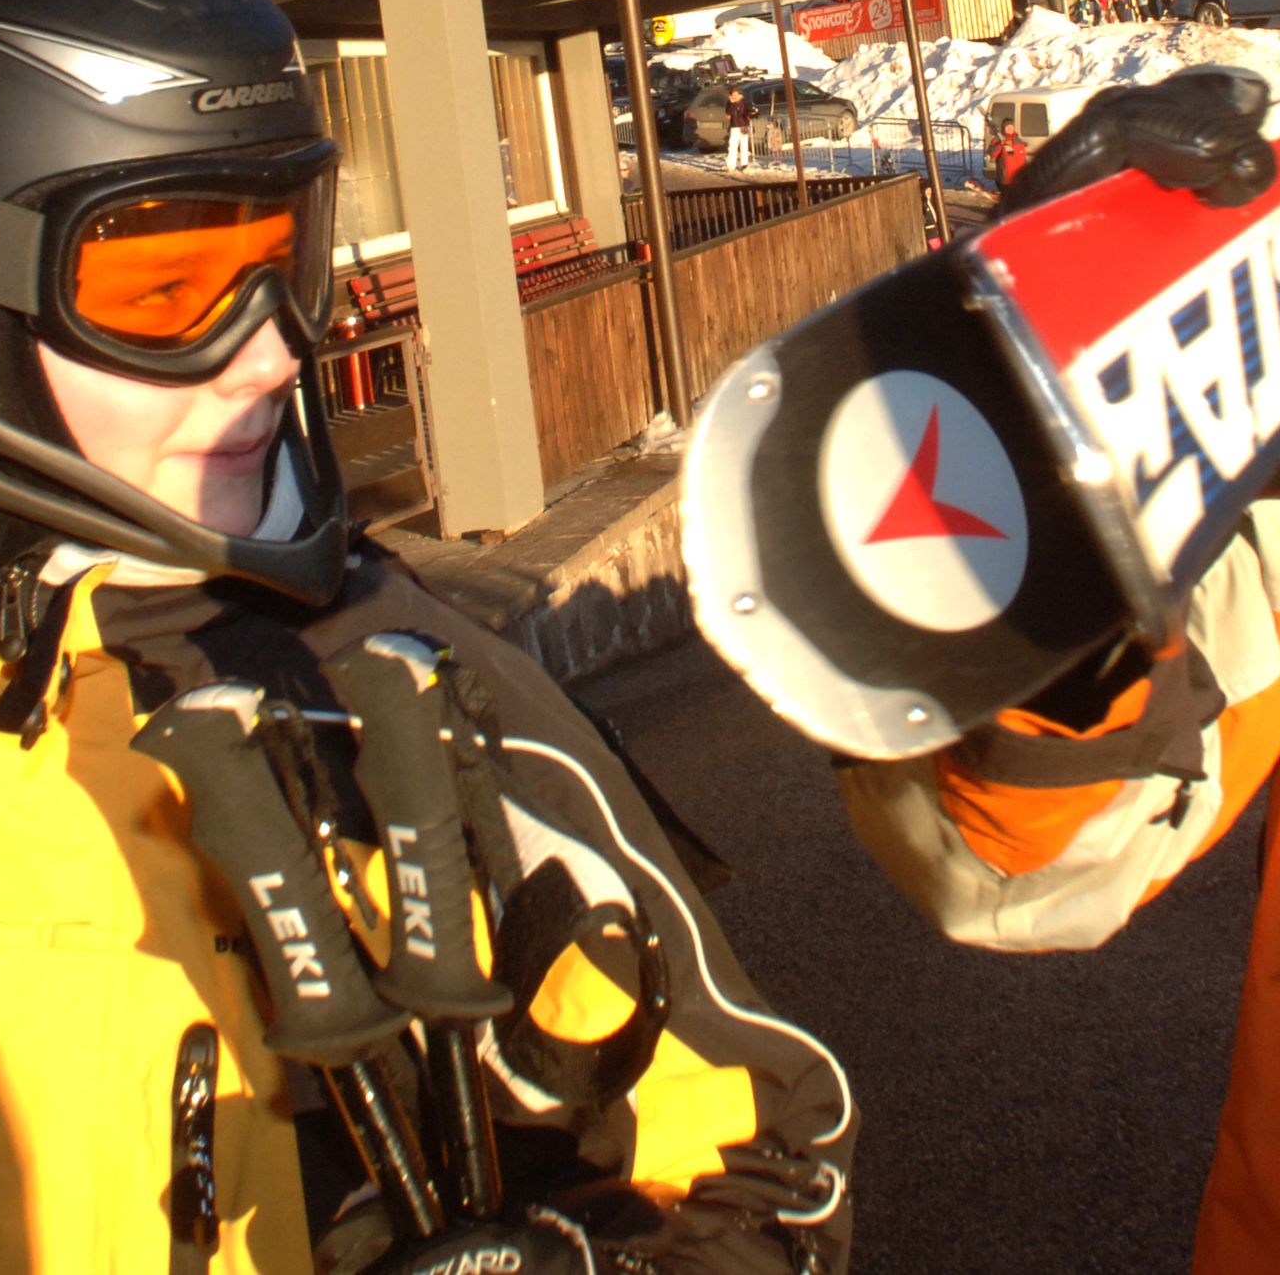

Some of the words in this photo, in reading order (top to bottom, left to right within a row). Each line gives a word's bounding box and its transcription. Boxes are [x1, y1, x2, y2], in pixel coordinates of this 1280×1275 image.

[197, 81, 295, 112] CARRERA
[248, 871, 332, 999] LEKI
[388, 825, 436, 961] LEKI
